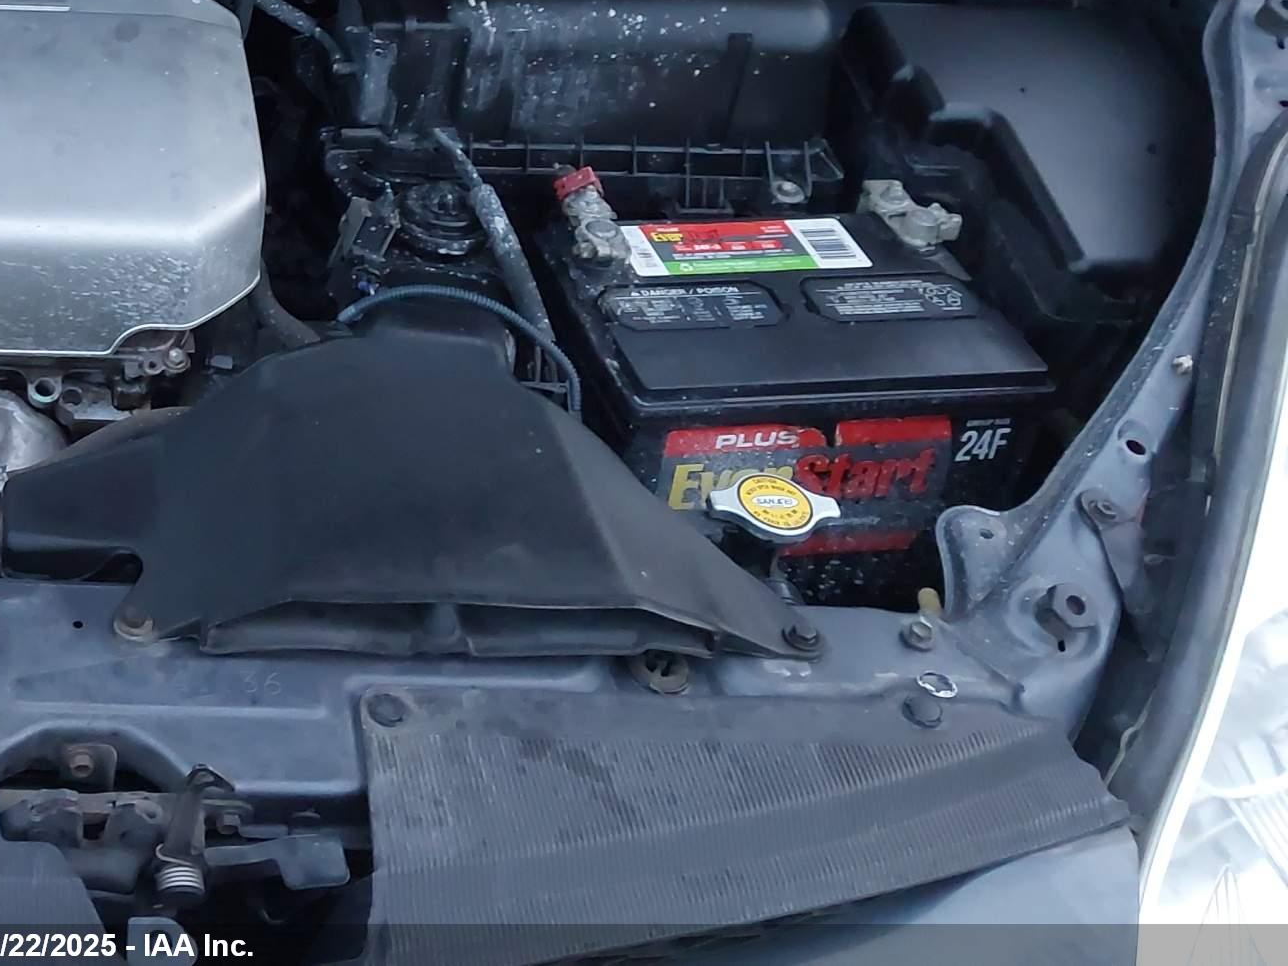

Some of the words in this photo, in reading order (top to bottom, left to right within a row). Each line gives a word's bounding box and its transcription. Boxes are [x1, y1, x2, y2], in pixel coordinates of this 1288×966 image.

[640, 288, 687, 297] DANGER
[715, 430, 800, 450] PLUS
[955, 427, 1012, 462] 24F
